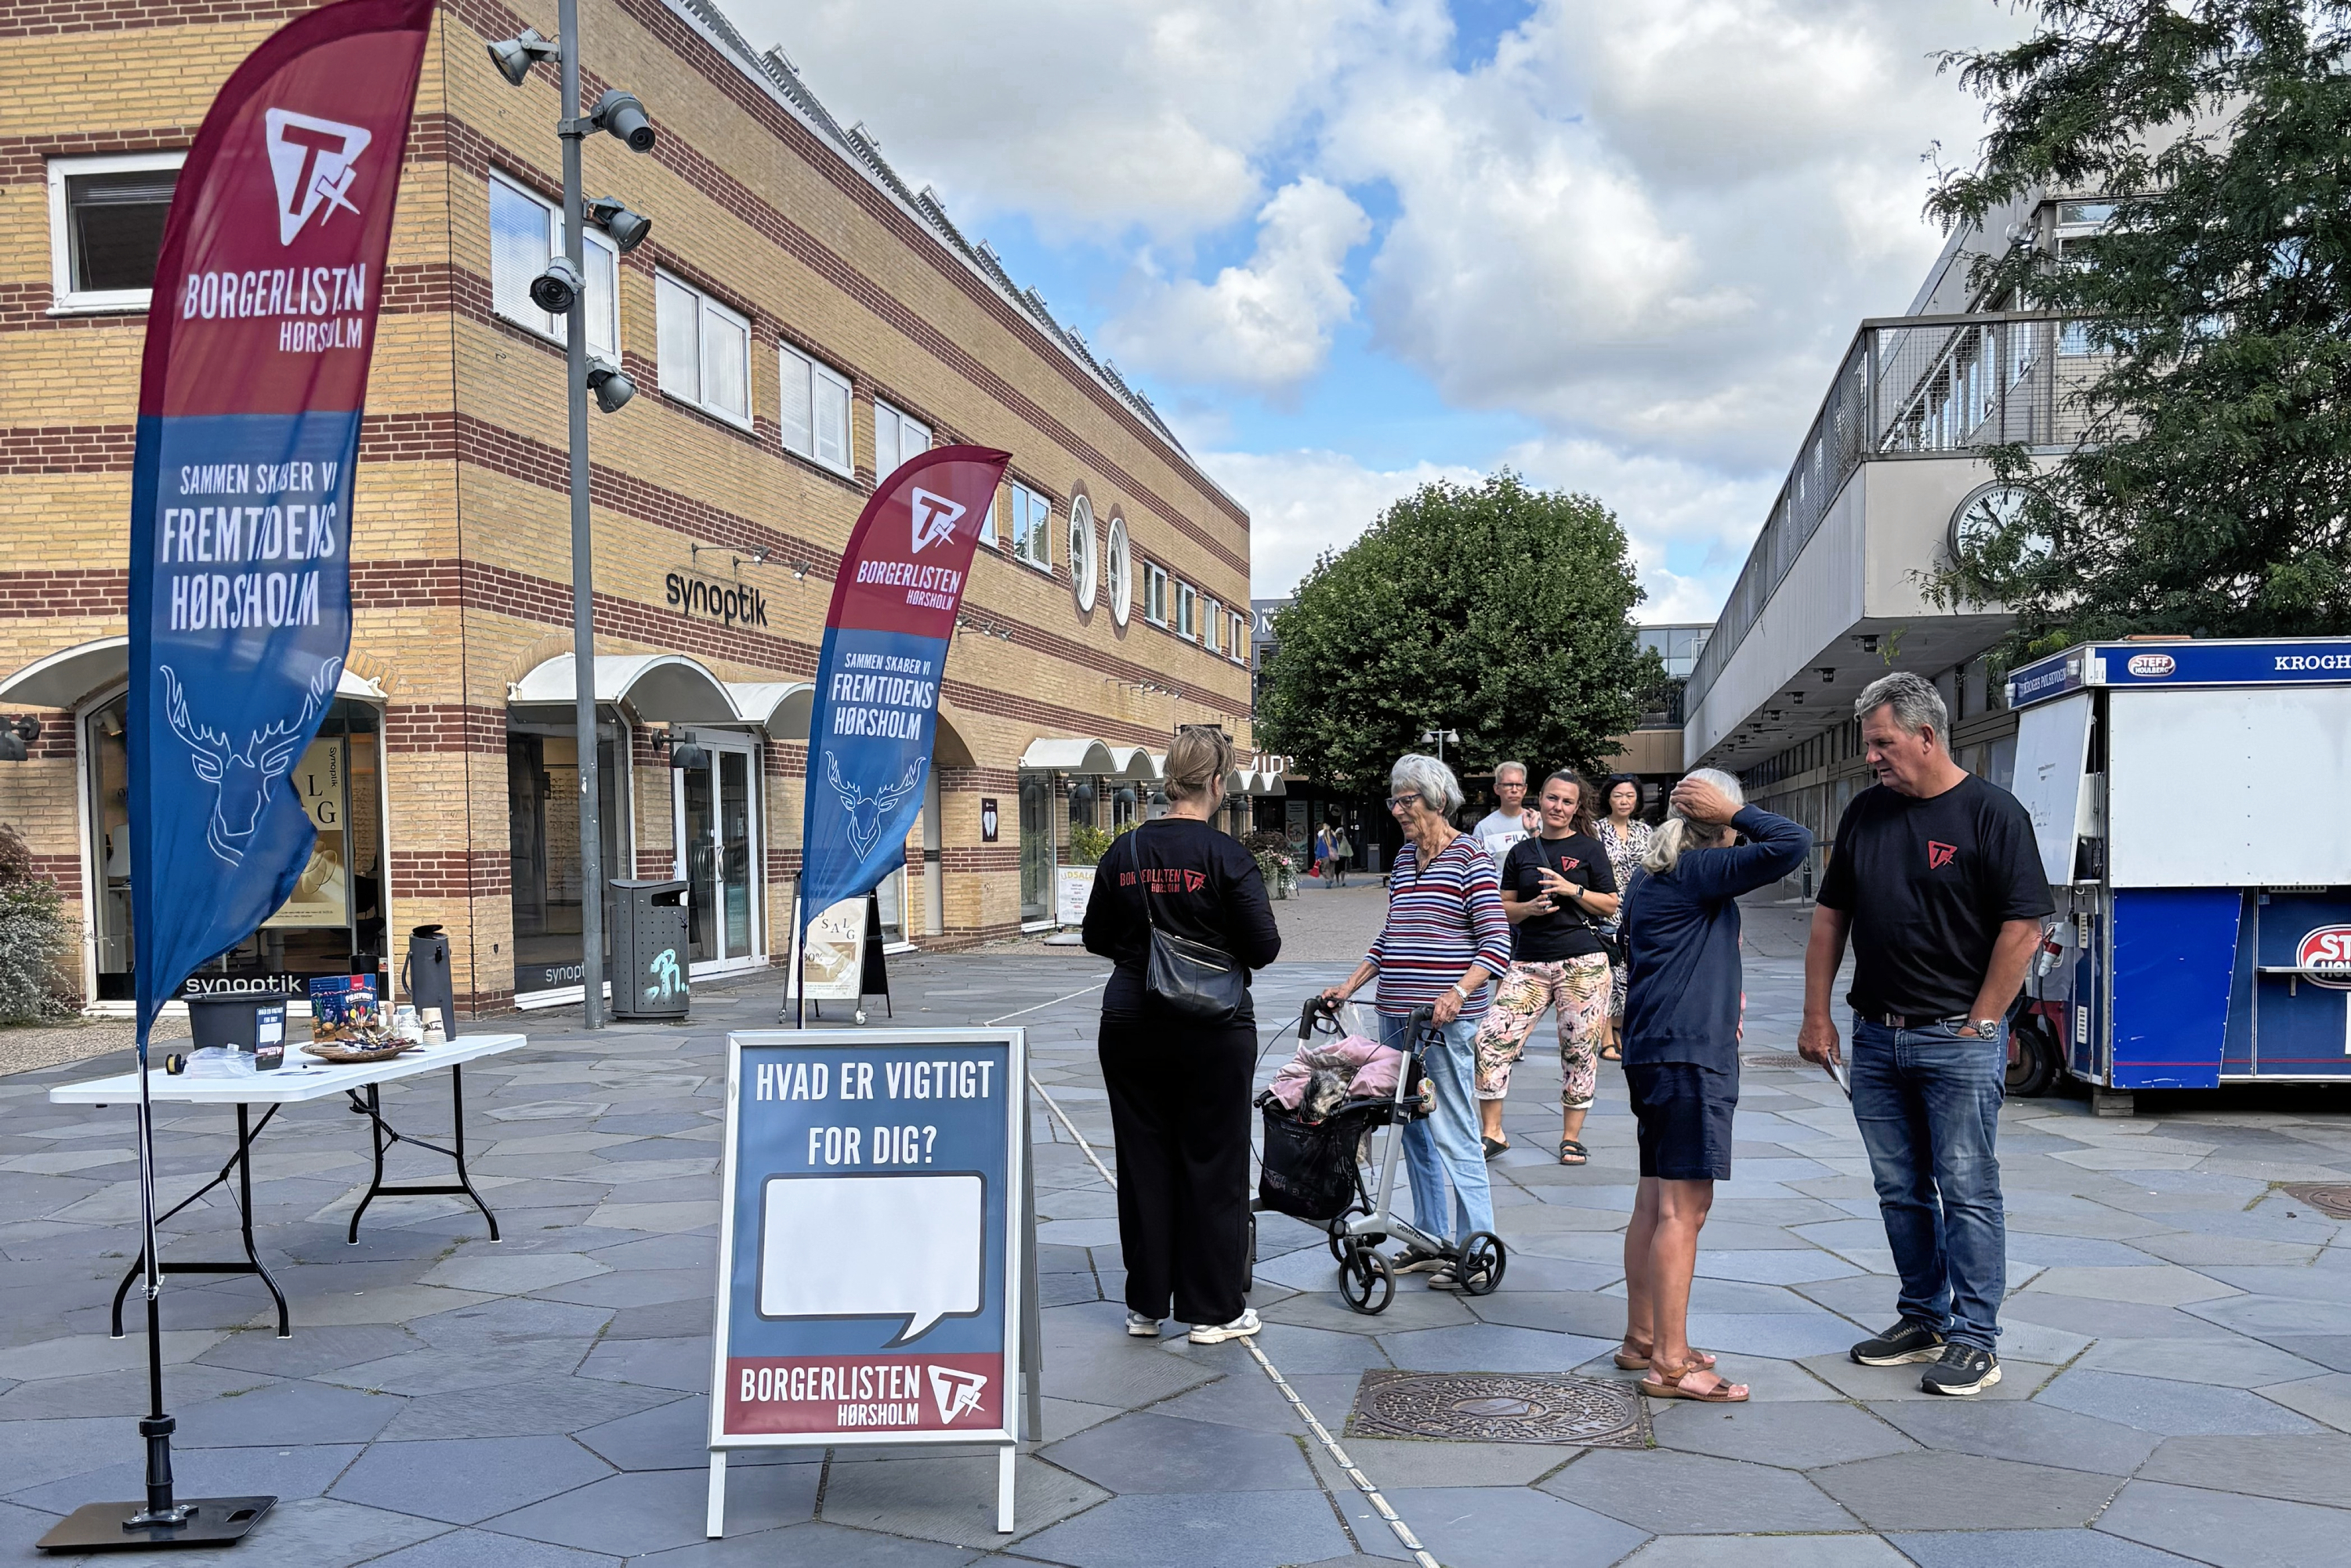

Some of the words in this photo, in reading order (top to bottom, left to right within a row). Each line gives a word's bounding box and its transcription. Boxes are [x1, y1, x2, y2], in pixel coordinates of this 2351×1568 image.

[183, 263, 366, 320] BORGERLISTN
[279, 317, 363, 353] HØRSOLM
[180, 464, 249, 495] SAMMEN
[321, 461, 338, 492] VI
[161, 502, 336, 563] FREMTIDENS
[856, 560, 962, 594] BORGERLISTEN
[170, 570, 320, 632] HØRSHOLM
[666, 573, 768, 628] synoptik
[845, 652, 883, 670] SAMMEN
[885, 655, 921, 674] SKABER
[922, 661, 931, 675] VI
[2135, 657, 2170, 668] STEFF
[2274, 655, 2351, 671] KROGH
[831, 673, 934, 709] FREMTIDENS
[833, 706, 922, 741] HØRSHOLM
[1505, 834, 1528, 844] FILA
[186, 975, 302, 994] synoptik
[545, 961, 585, 985] synopt
[756, 1063, 829, 1101] HVAD
[840, 1062, 874, 1099] ER
[885, 1060, 994, 1099] VIGTIGT
[808, 1126, 861, 1165] FOR
[872, 1125, 937, 1164] DIG?
[740, 1365, 920, 1402] BORGERLISTEN
[837, 1403, 919, 1426] HØRSHOLM
